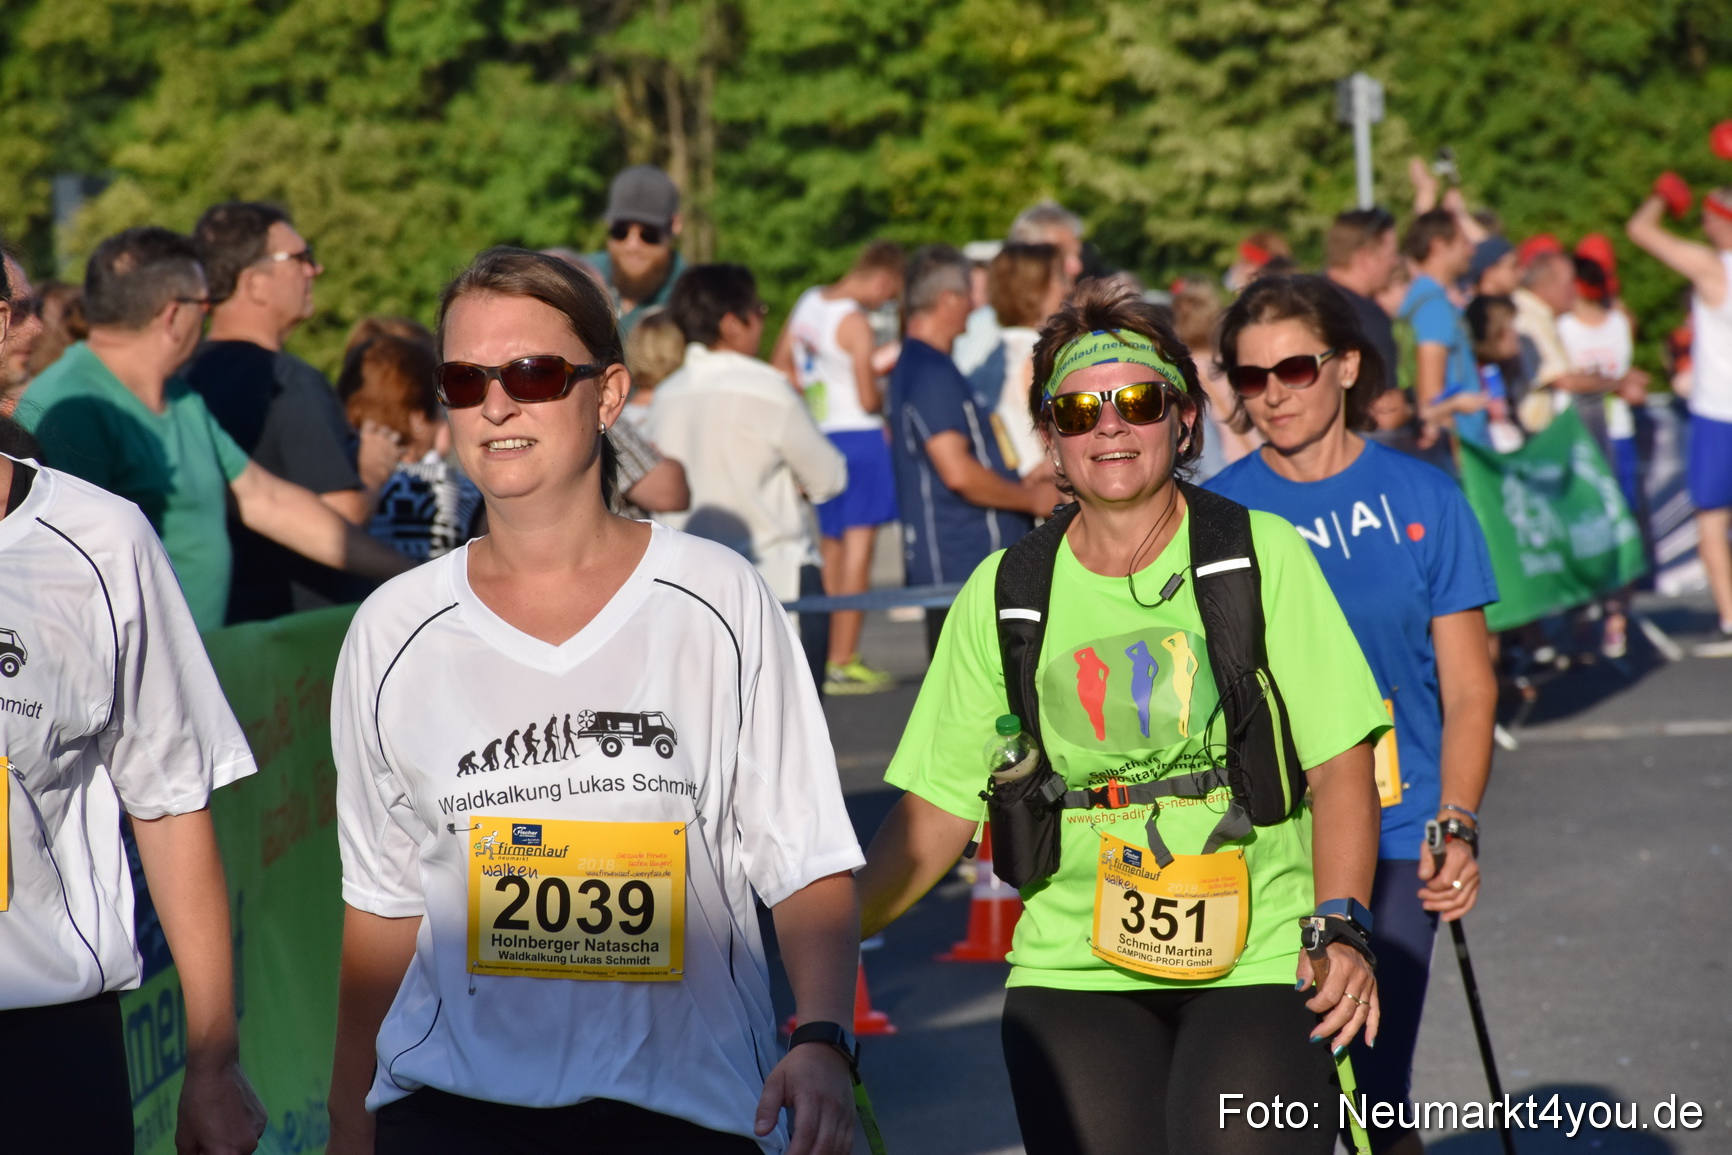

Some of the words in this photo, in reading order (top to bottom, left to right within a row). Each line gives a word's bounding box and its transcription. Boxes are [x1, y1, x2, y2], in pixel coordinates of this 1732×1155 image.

[438, 783, 562, 816] Waldkalkung
[568, 775, 626, 796] Lukas
[498, 842, 570, 858] firmenlauf
[482, 863, 538, 879] walken
[577, 857, 615, 871] 2018
[1113, 858, 1161, 881] firmenlauf
[1104, 872, 1138, 891] walken
[1167, 883, 1199, 894] 2018
[492, 876, 655, 936] 2039
[1121, 890, 1206, 943] 351
[491, 933, 580, 953] Holnberger
[585, 938, 659, 953] Natascha
[1118, 933, 1161, 954] Schmid
[1165, 944, 1213, 957] Martina
[498, 950, 567, 965] Waldkalkung
[570, 954, 602, 965] Lukas
[605, 955, 651, 966] Schmidt
[1116, 945, 1184, 967] CAMPING-PROFI
[1187, 958, 1213, 967] GmbH
